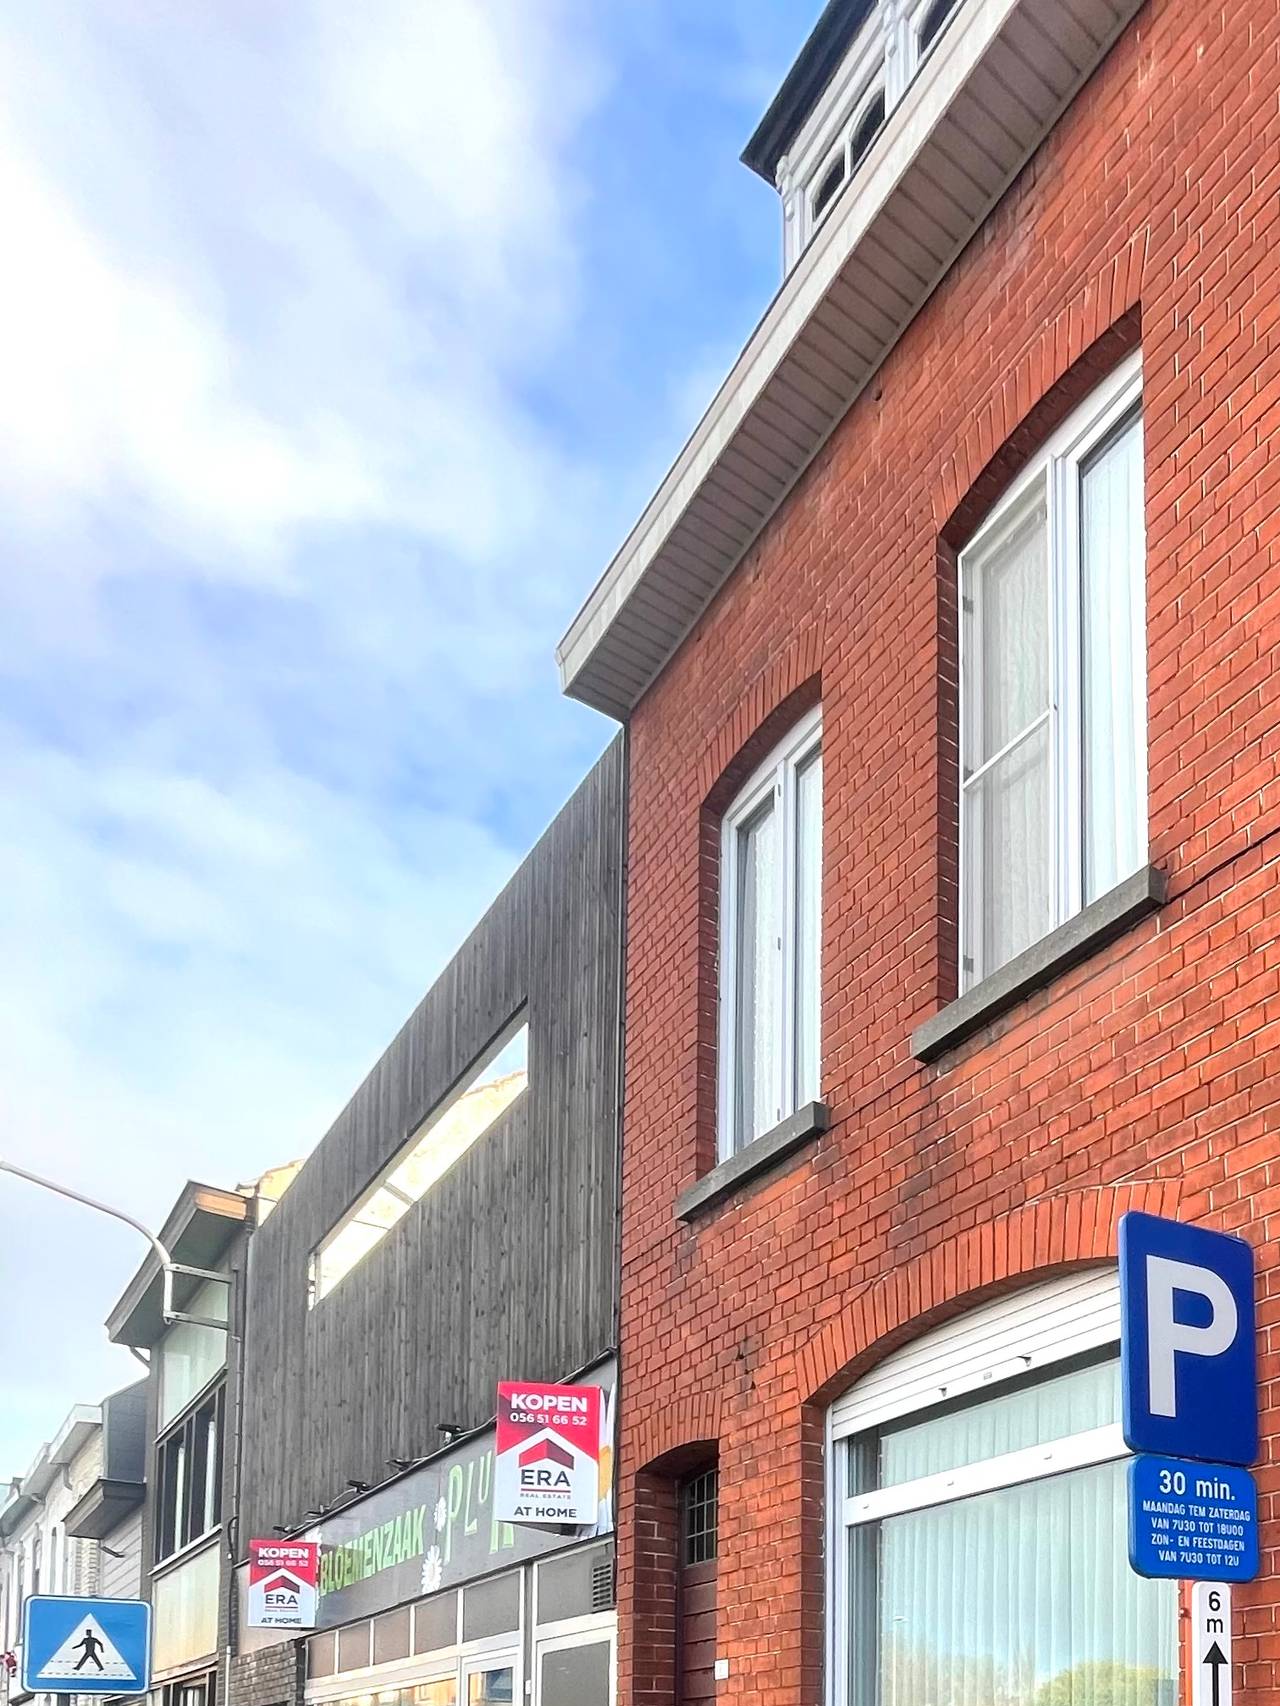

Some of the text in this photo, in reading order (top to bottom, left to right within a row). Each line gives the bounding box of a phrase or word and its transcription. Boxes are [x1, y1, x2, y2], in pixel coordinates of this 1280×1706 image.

[1146, 1254, 1238, 1418] P
[510, 1393, 588, 1412] KOPEN
[510, 1412, 588, 1426] 056 51 66 52
[520, 1469, 571, 1487] ERA
[1159, 1470, 1236, 1501] 30 min.
[513, 1506, 577, 1518] AT HOME
[1142, 1500, 1251, 1522] MAANDAG TEM ZATERDAG
[1151, 1517, 1244, 1537] VAN 7U30 TOT 18U00
[320, 1504, 426, 1596] BLOEMENZAAK
[1151, 1533, 1245, 1552] ZON- EN FEESTDAGEN
[258, 1547, 309, 1559] KOPEN
[1158, 1549, 1240, 1567] VAN 7U30 TOT 12U
[265, 1594, 299, 1606] ERA
[1208, 1591, 1221, 1612] 6
[1206, 1618, 1224, 1634] m
